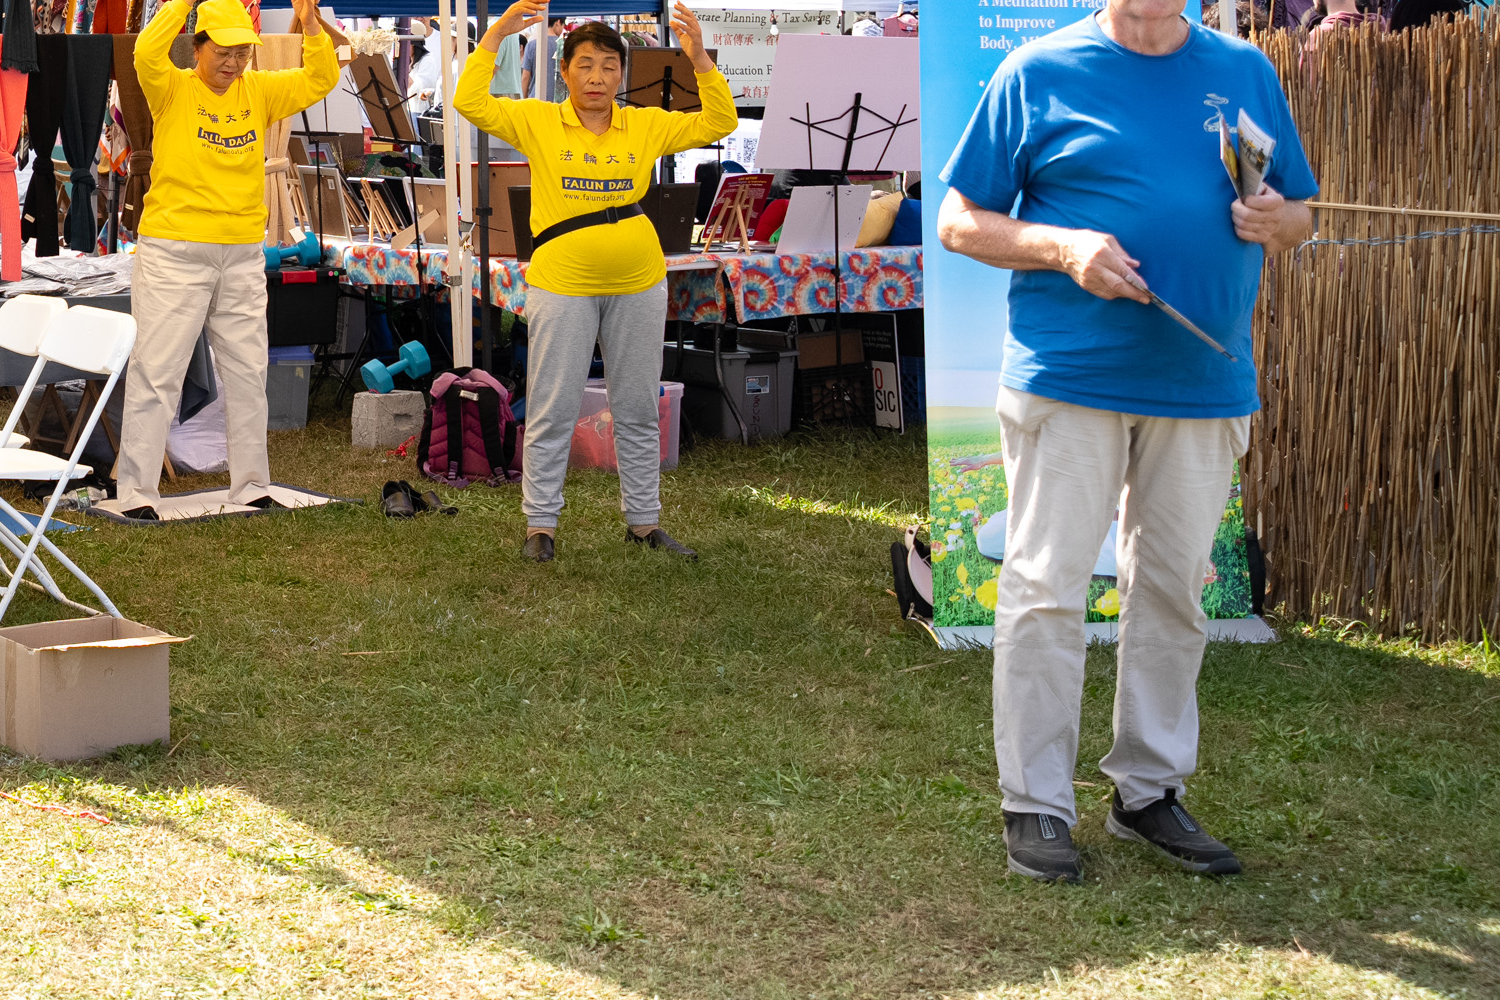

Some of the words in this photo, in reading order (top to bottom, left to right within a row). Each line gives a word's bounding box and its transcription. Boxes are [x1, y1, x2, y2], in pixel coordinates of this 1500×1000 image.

[723, 12, 767, 27] Planning
[782, 12, 801, 23] Tax
[802, 12, 831, 25] Savng
[978, 15, 993, 28] to
[995, 14, 1055, 32] Improve
[717, 64, 764, 76] Education
[564, 178, 604, 191] FALUN
